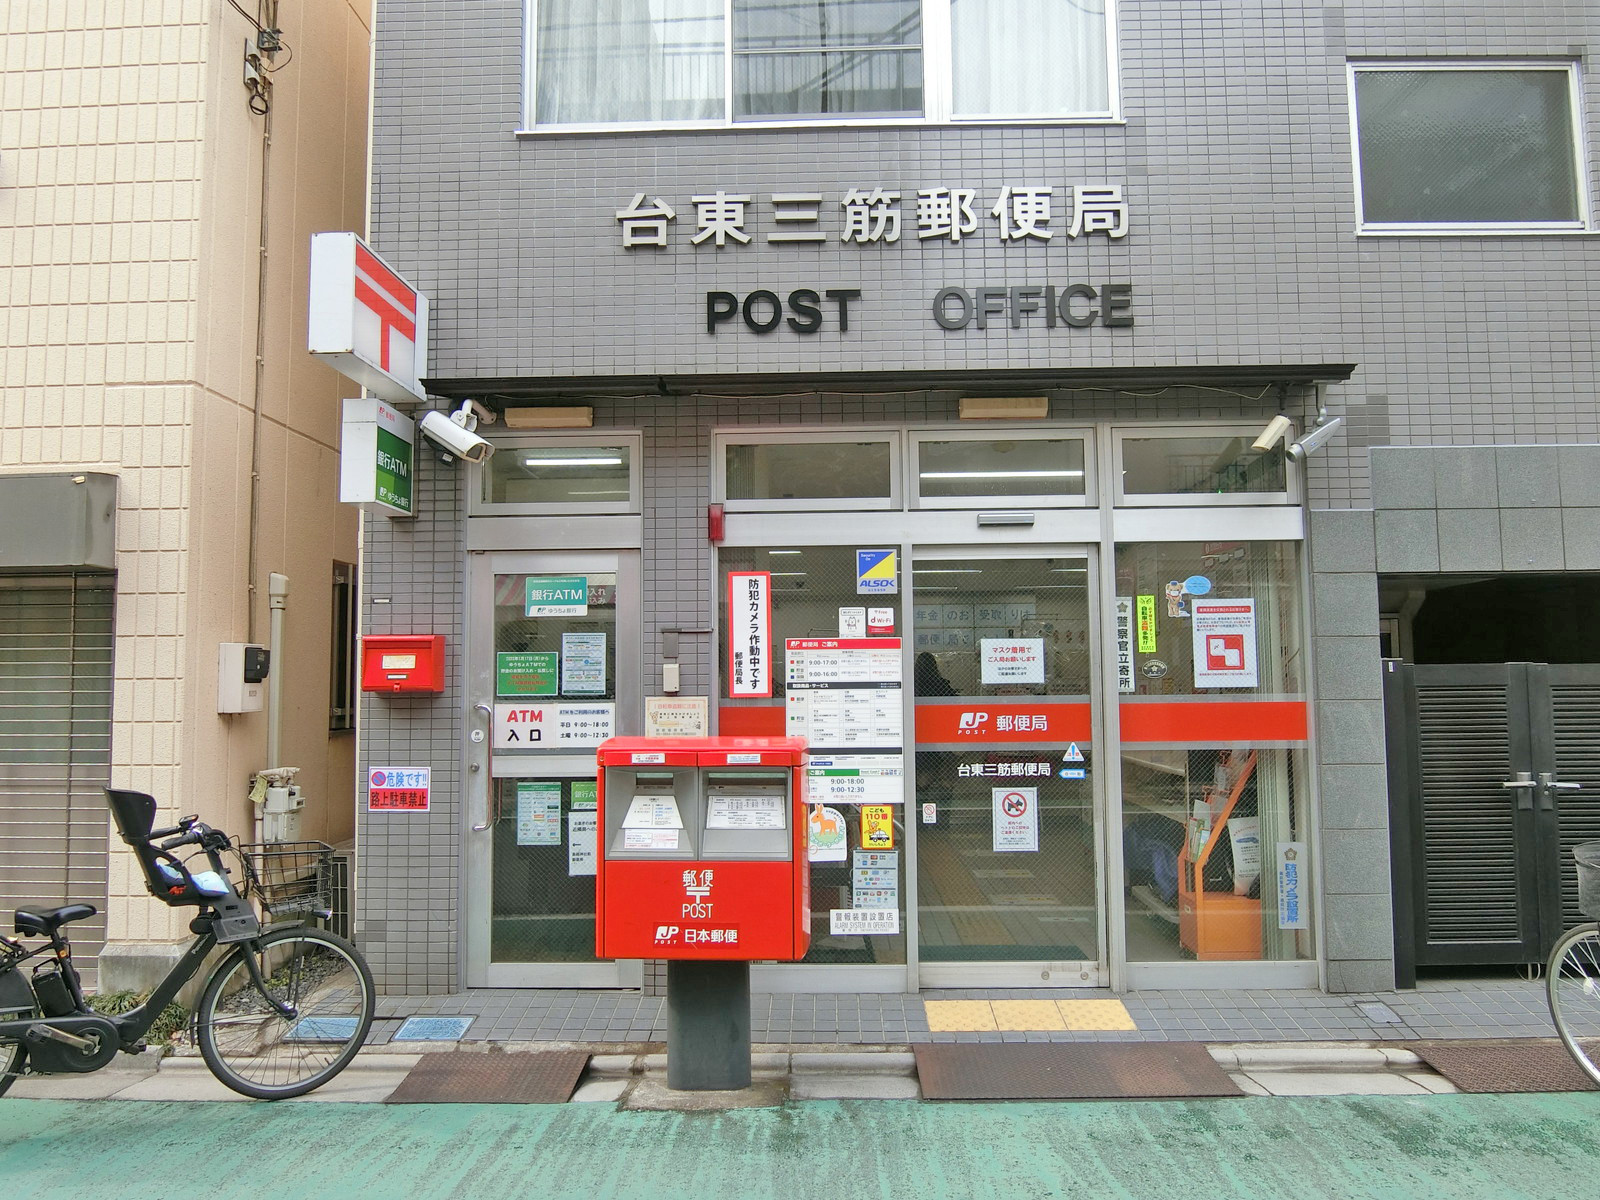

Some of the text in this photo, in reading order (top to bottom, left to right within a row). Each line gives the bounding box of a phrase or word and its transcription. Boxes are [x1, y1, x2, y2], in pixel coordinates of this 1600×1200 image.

[616, 184, 1129, 248] 台東三筋郵便局
[706, 283, 1134, 334] POST OFFICE
[377, 449, 407, 478] 銀行ATM
[388, 492, 409, 508] ゆうちょ銀行
[860, 579, 895, 587] ALSOK
[531, 589, 583, 601] 銀行ATM
[748, 579, 760, 690] 防犯カメラ作動中です
[992, 646, 1032, 654] マスク着用で
[1116, 616, 1130, 689] 警察官立寄所
[735, 652, 743, 685] 郵便局長
[507, 710, 543, 722] ATM
[996, 715, 1048, 731] 郵便局
[507, 729, 541, 742] 入口
[957, 763, 1051, 777] 台東三筋郵便局
[371, 791, 427, 807] 路上駐車禁止
[682, 869, 714, 887] 郵便
[682, 903, 714, 918] POST
[685, 929, 738, 943] 日本郵便
